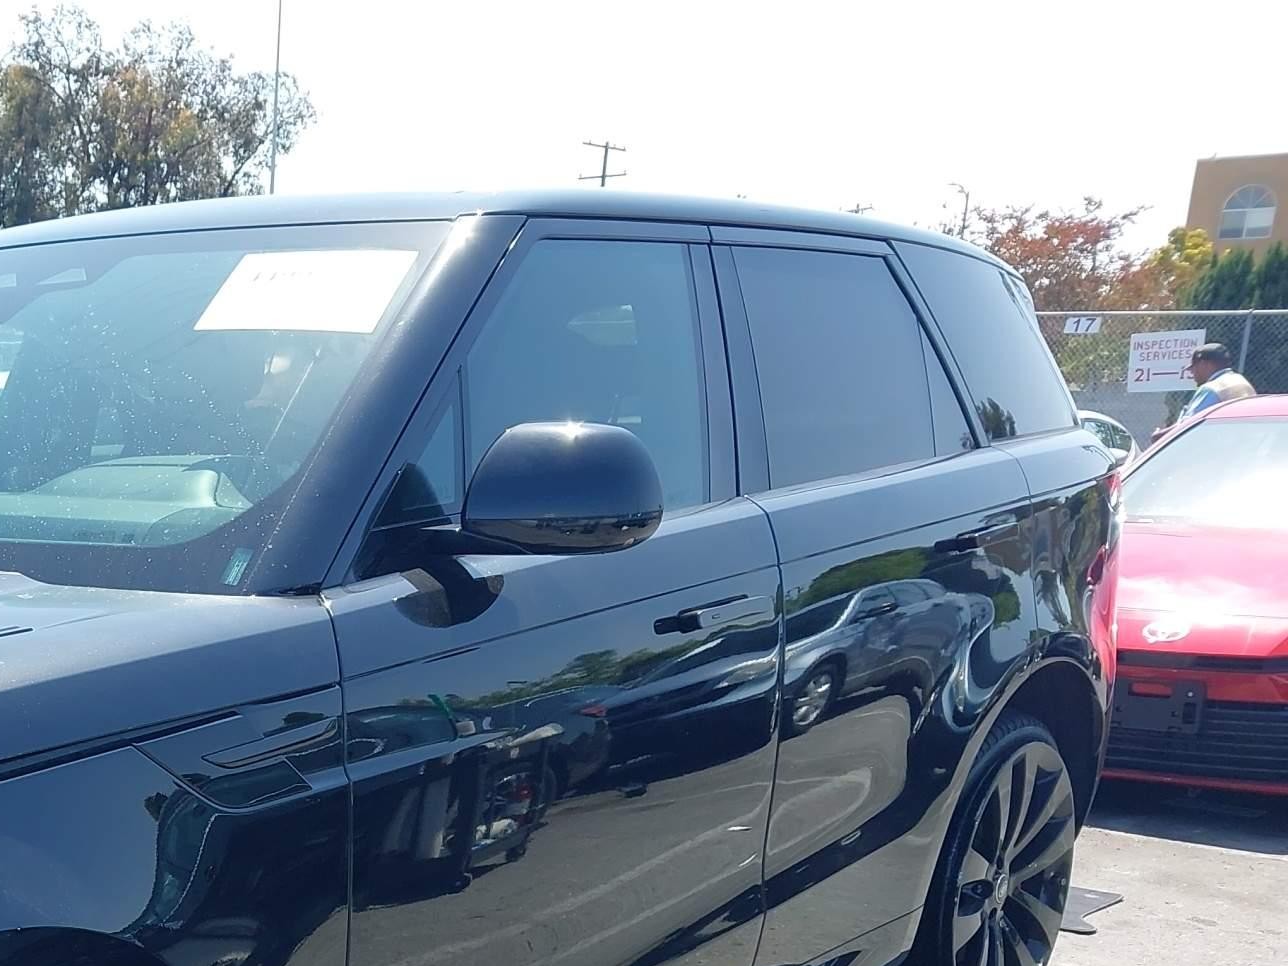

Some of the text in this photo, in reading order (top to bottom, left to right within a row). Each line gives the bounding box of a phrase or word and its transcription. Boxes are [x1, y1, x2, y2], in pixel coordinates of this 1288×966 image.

[1073, 317, 1097, 332] 17
[1133, 338, 1198, 351] INSPECTION
[1139, 348, 1192, 361] SERVICES
